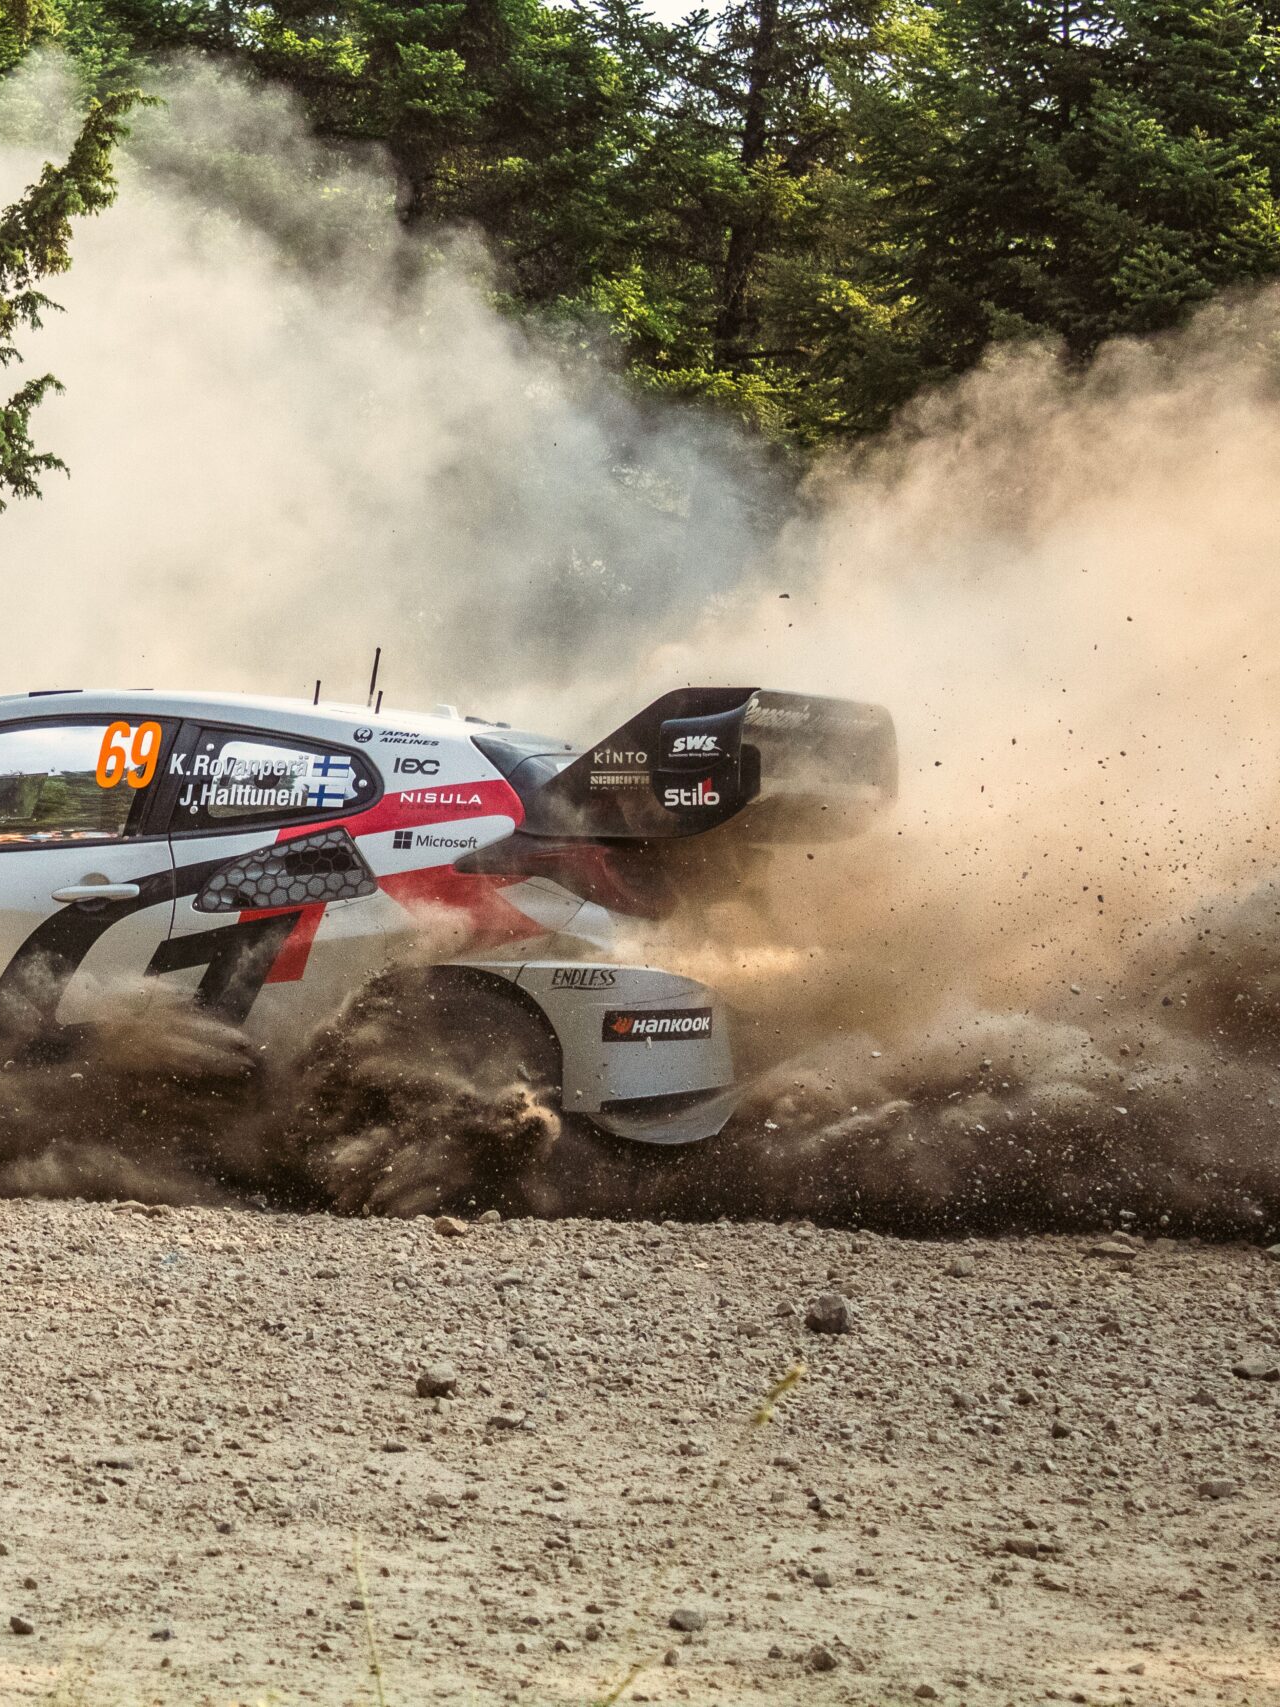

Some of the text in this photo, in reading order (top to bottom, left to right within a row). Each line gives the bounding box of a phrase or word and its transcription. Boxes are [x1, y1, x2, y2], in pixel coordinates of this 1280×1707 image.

[379, 730, 420, 738] JAPAN
[380, 737, 440, 746] AIRLINES
[96, 721, 162, 789] 69
[179, 784, 303, 806] J.Halttunen
[400, 792, 482, 804] NISULA
[664, 782, 720, 807] Stilo
[416, 835, 478, 849] Microsoft
[551, 968, 618, 986] ENDLESS
